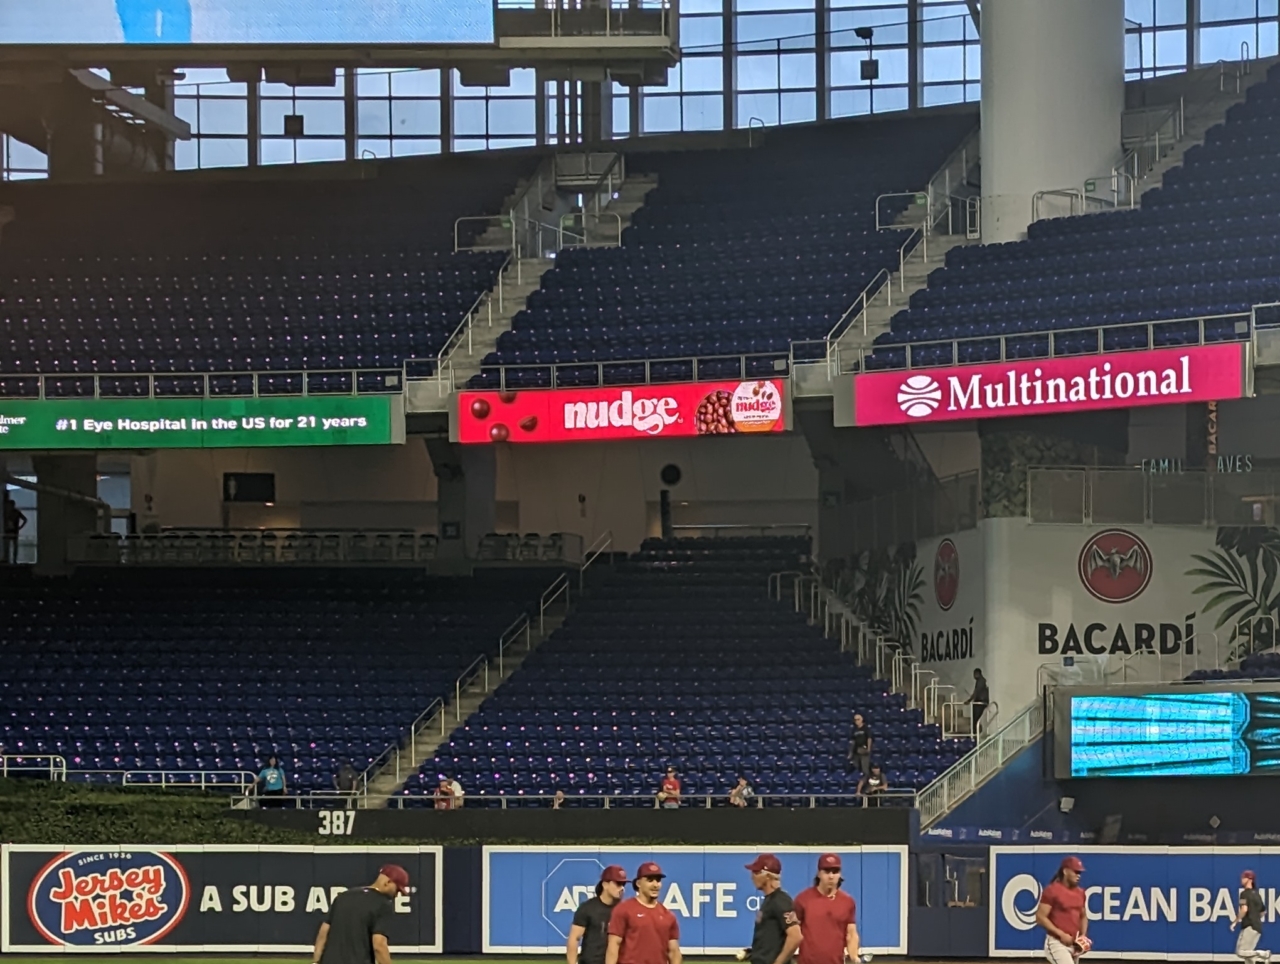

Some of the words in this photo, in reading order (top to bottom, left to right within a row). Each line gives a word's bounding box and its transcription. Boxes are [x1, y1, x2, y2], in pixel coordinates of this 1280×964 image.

[947, 355, 1193, 412] Multinational
[56, 419, 77, 431] #1
[83, 418, 114, 433] Eye
[117, 417, 188, 433] Hospital
[191, 417, 207, 430] in
[211, 417, 238, 430] the
[241, 417, 266, 430] US
[269, 416, 293, 429] for
[297, 416, 316, 429] 21
[321, 416, 367, 430] years
[564, 390, 680, 435] nudge
[921, 616, 974, 664] BACARDÍ
[1037, 611, 1197, 656] BACARDÍ
[318, 810, 356, 836] 387
[77, 853, 104, 866] SINCE
[50, 865, 164, 901] Jersey
[199, 885, 223, 913] A
[232, 885, 296, 913] SUB
[94, 927, 137, 945] SUBS
